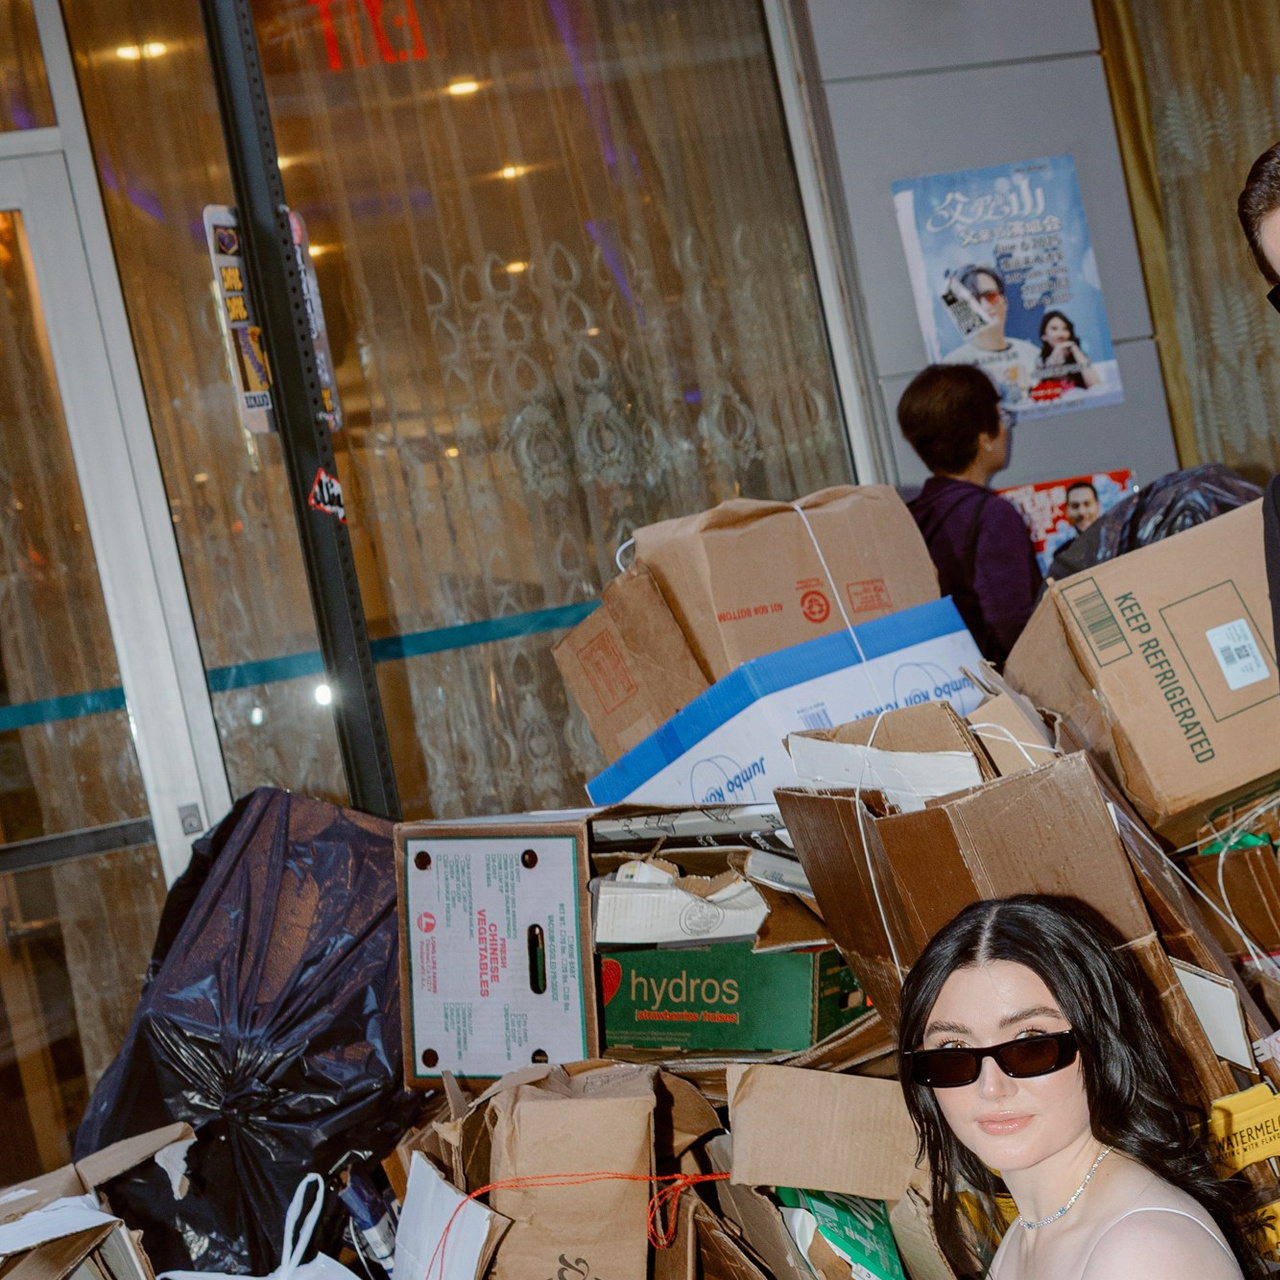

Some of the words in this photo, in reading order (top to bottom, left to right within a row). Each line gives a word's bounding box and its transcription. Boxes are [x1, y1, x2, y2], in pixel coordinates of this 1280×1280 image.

[716, 607, 752, 623] BOTTOM
[1114, 591, 1151, 635] KEEP
[1138, 637, 1216, 764] REFRIGERATED
[722, 755, 772, 797] Jumbo
[700, 786, 728, 811] Ro
[475, 908, 489, 998] VEGETABLES
[487, 922, 499, 984] CHINESE
[498, 937, 507, 968] FRESH
[631, 969, 739, 1010] hydros
